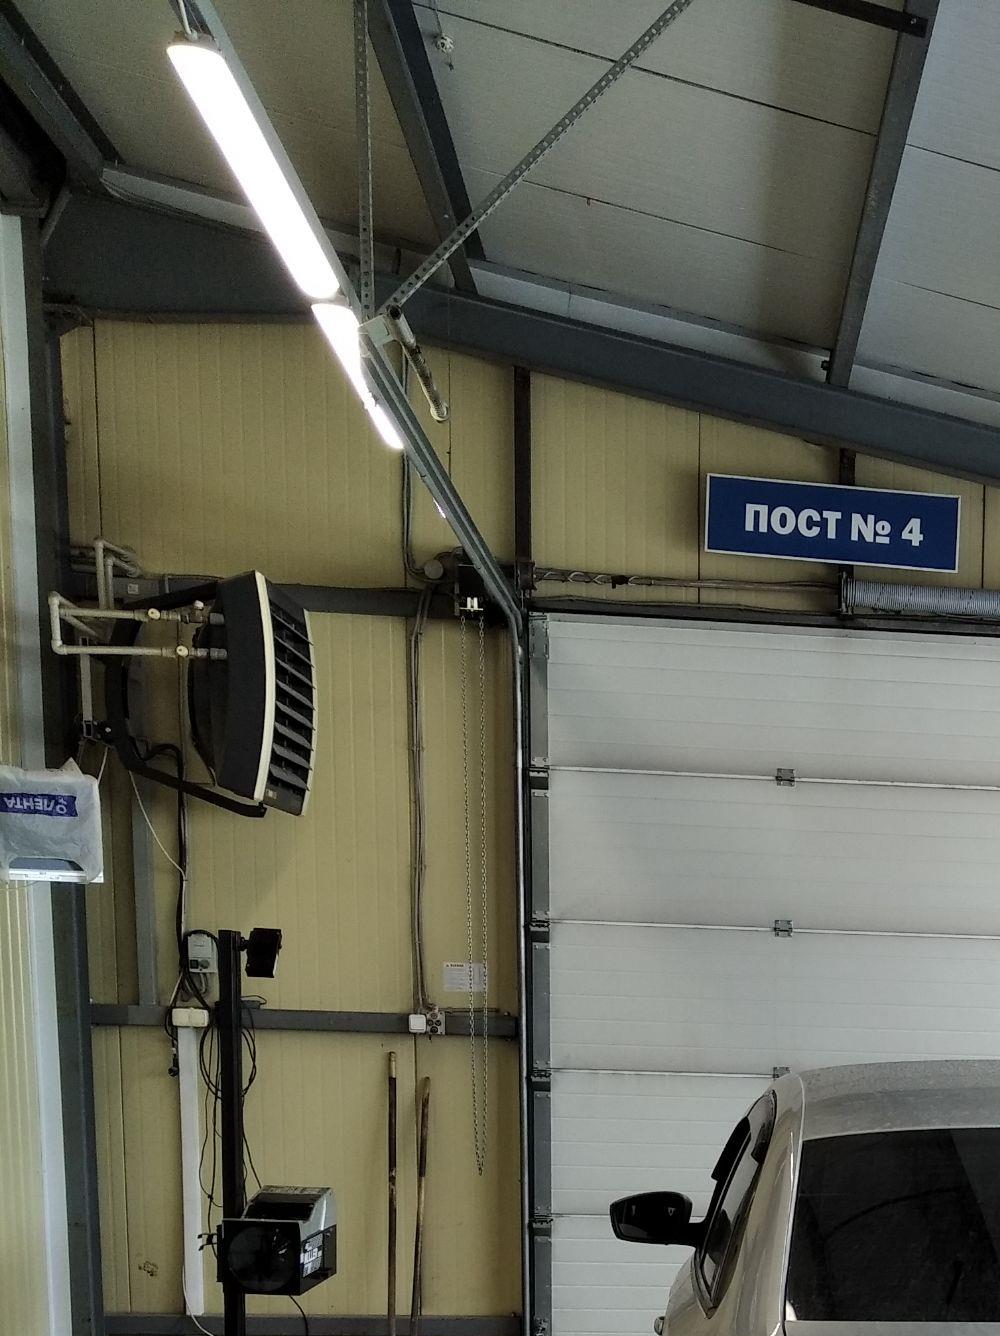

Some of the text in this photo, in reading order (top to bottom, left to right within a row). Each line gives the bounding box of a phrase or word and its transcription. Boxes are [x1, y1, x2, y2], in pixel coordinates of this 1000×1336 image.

[744, 503, 924, 547] ПОСТ № 4
[3, 797, 55, 812] ЛЕНТА
